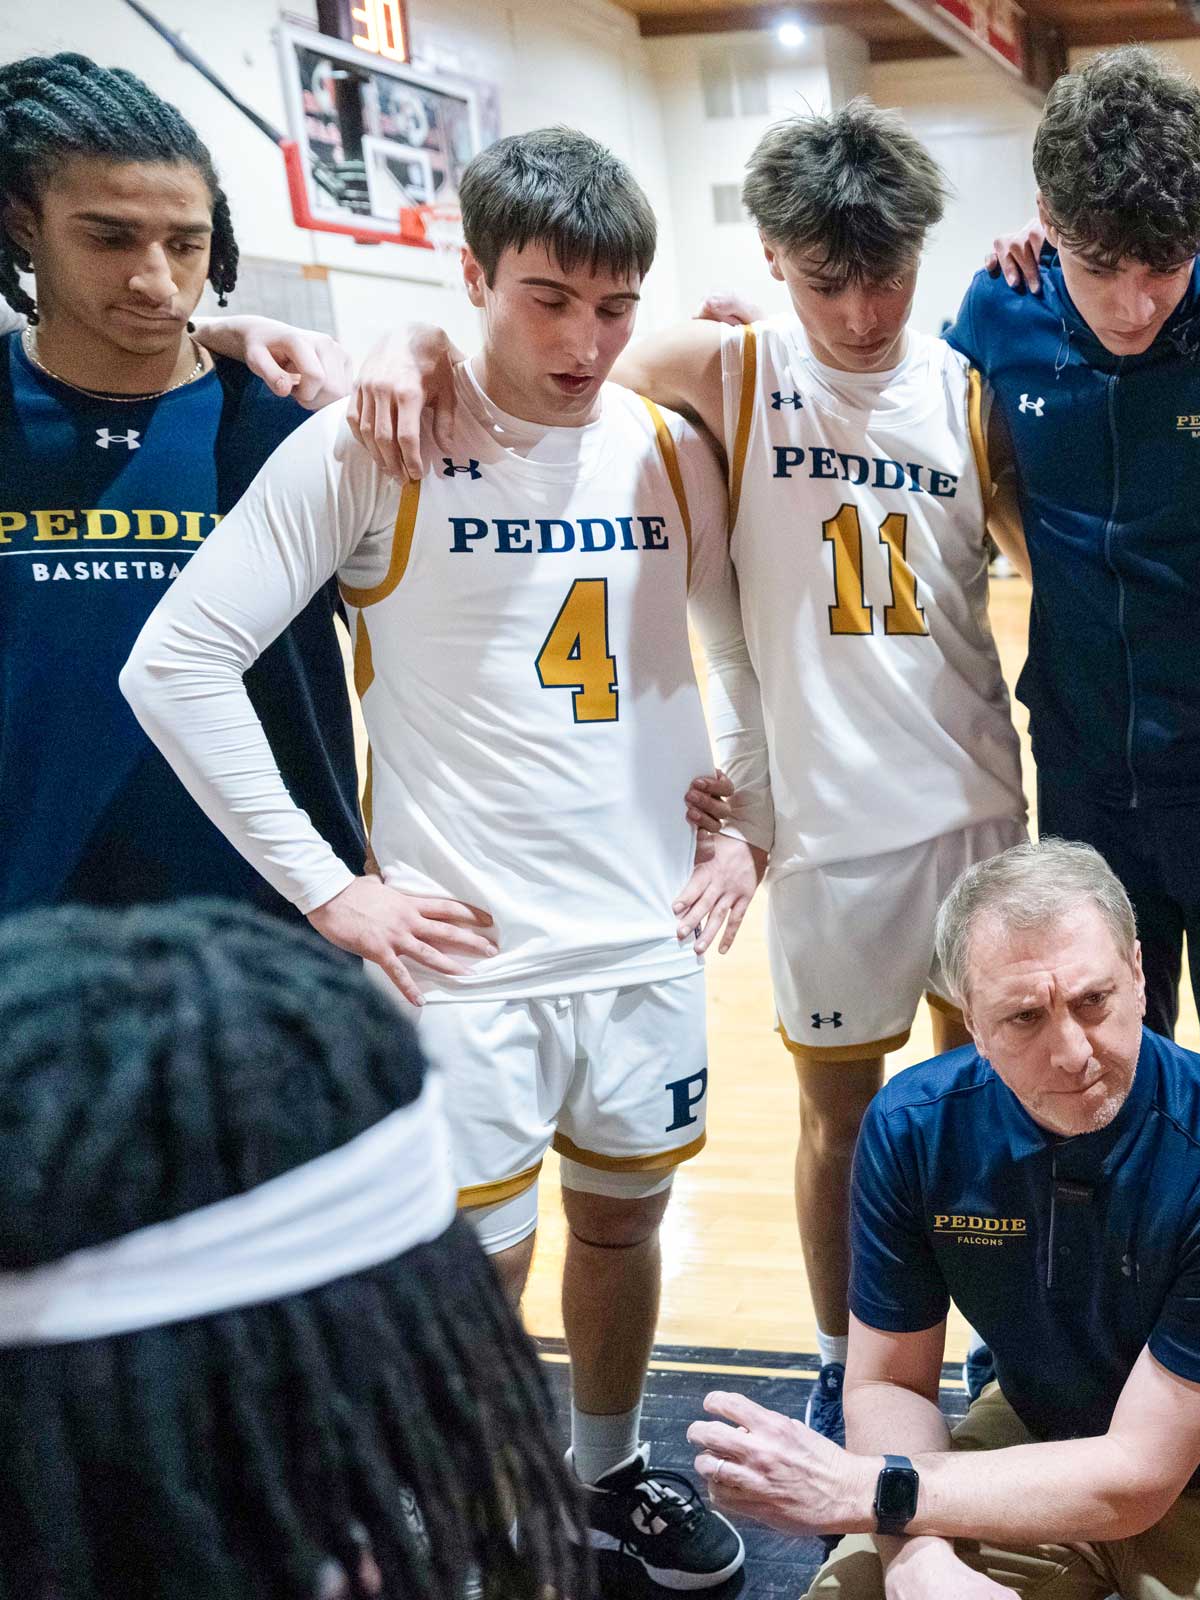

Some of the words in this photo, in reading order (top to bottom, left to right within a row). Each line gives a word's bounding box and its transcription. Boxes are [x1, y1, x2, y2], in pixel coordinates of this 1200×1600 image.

[773, 446, 958, 498] PEDDIE
[0, 509, 224, 544] PEDDI
[448, 516, 669, 553] PEDDIE
[32, 562, 182, 582] BASKETBA
[822, 503, 929, 635] 11
[534, 577, 619, 723] 4
[665, 1067, 708, 1132] P
[934, 1215, 1026, 1231] PEDDIE
[957, 1236, 1003, 1246] FALCONS
